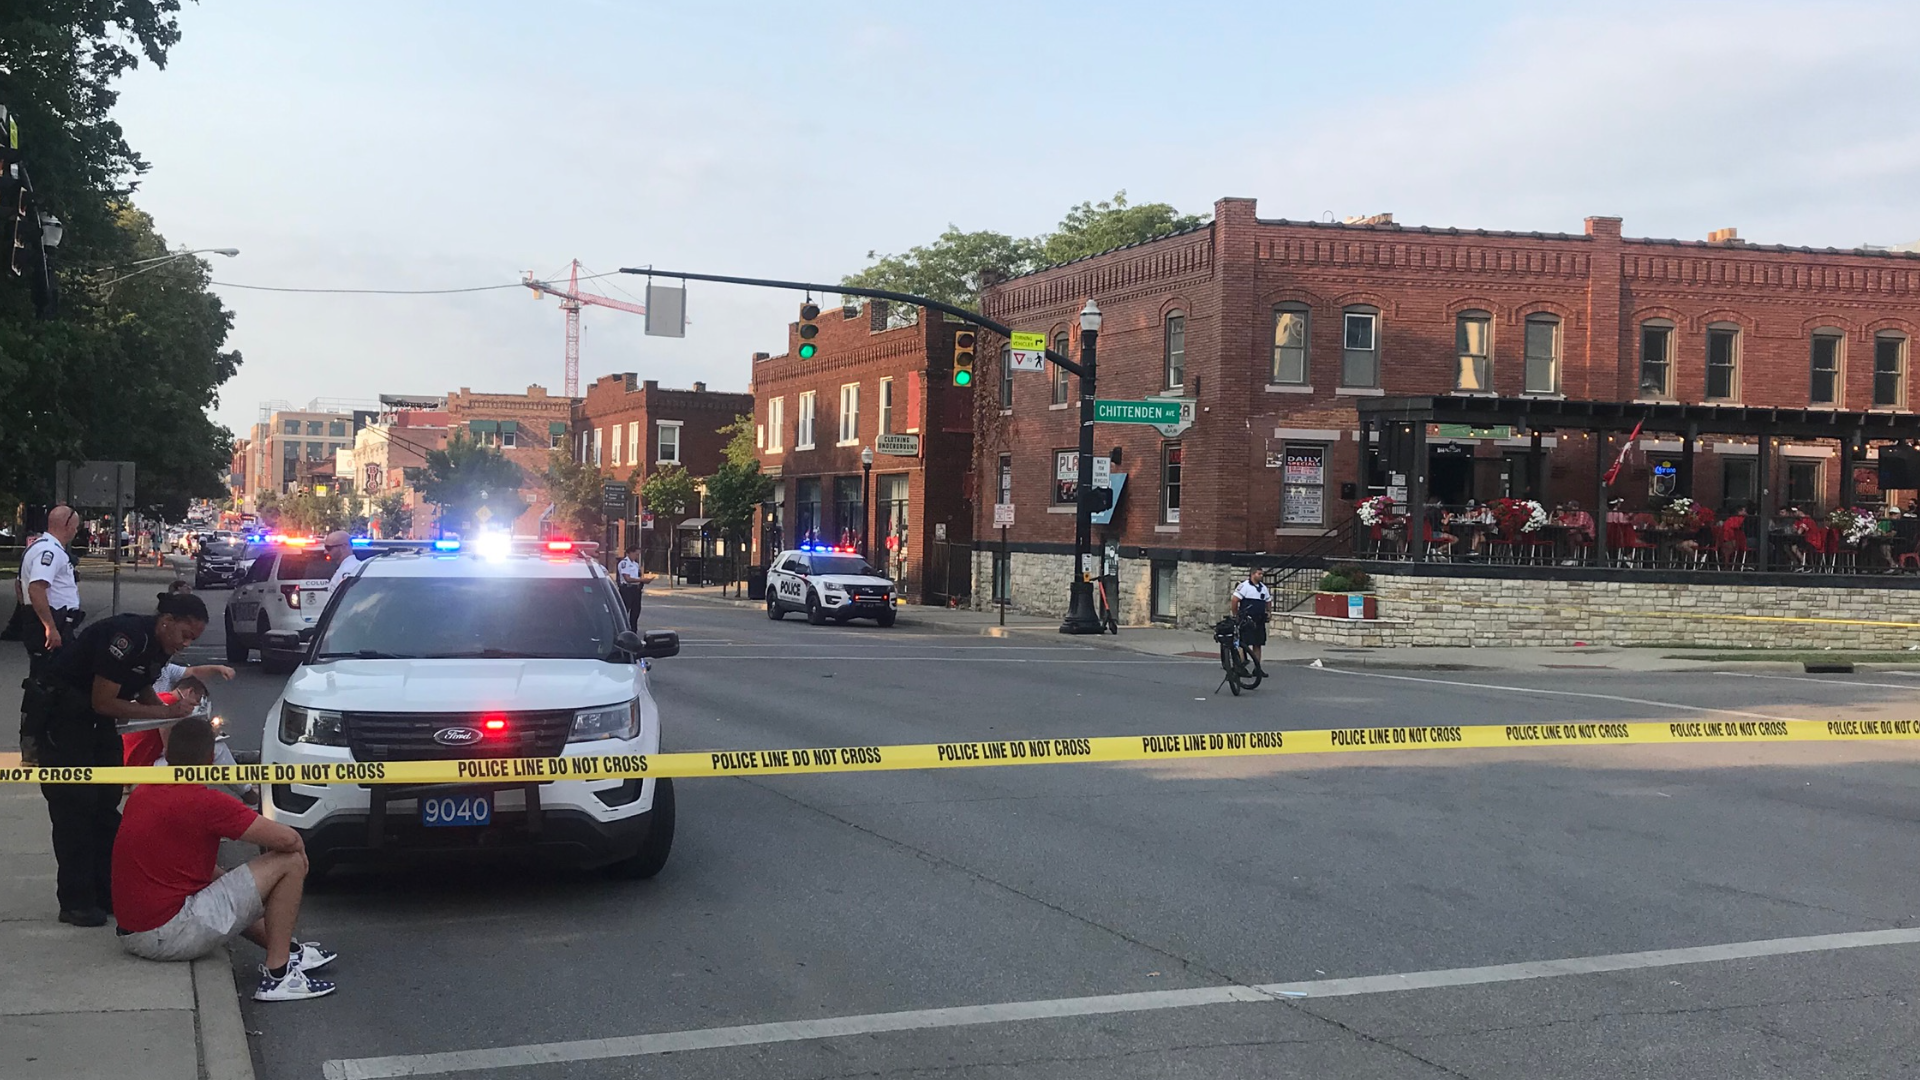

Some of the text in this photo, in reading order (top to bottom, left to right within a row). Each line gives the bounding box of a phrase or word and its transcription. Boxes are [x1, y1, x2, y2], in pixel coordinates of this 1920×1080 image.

[1099, 405, 1162, 418] CHITTENDEN
[780, 580, 801, 596] POLICE
[444, 729, 472, 740] Ford
[1506, 724, 1629, 740] POLICE LINE DO NOT CROSS
[1670, 722, 1788, 736] POLICE LINE DO NOT CROSS
[1828, 720, 1920, 734] POLICE LINE DO NOT C
[1143, 735, 1283, 752] POLICE LINE DO NOT CROSS
[1332, 728, 1462, 745] POLICE LINE DO NOT CROSS
[939, 741, 1092, 760] POLICE LINE DO NOT CROSS
[458, 758, 648, 777] POLICE LINE DO NOT CROSS
[713, 750, 882, 769] POLICE LINE DO NOT CROSS
[39, 769, 93, 781] CROSS
[175, 765, 385, 781] POLICE LINE DO NOT CROSS
[425, 797, 489, 823] 9040
